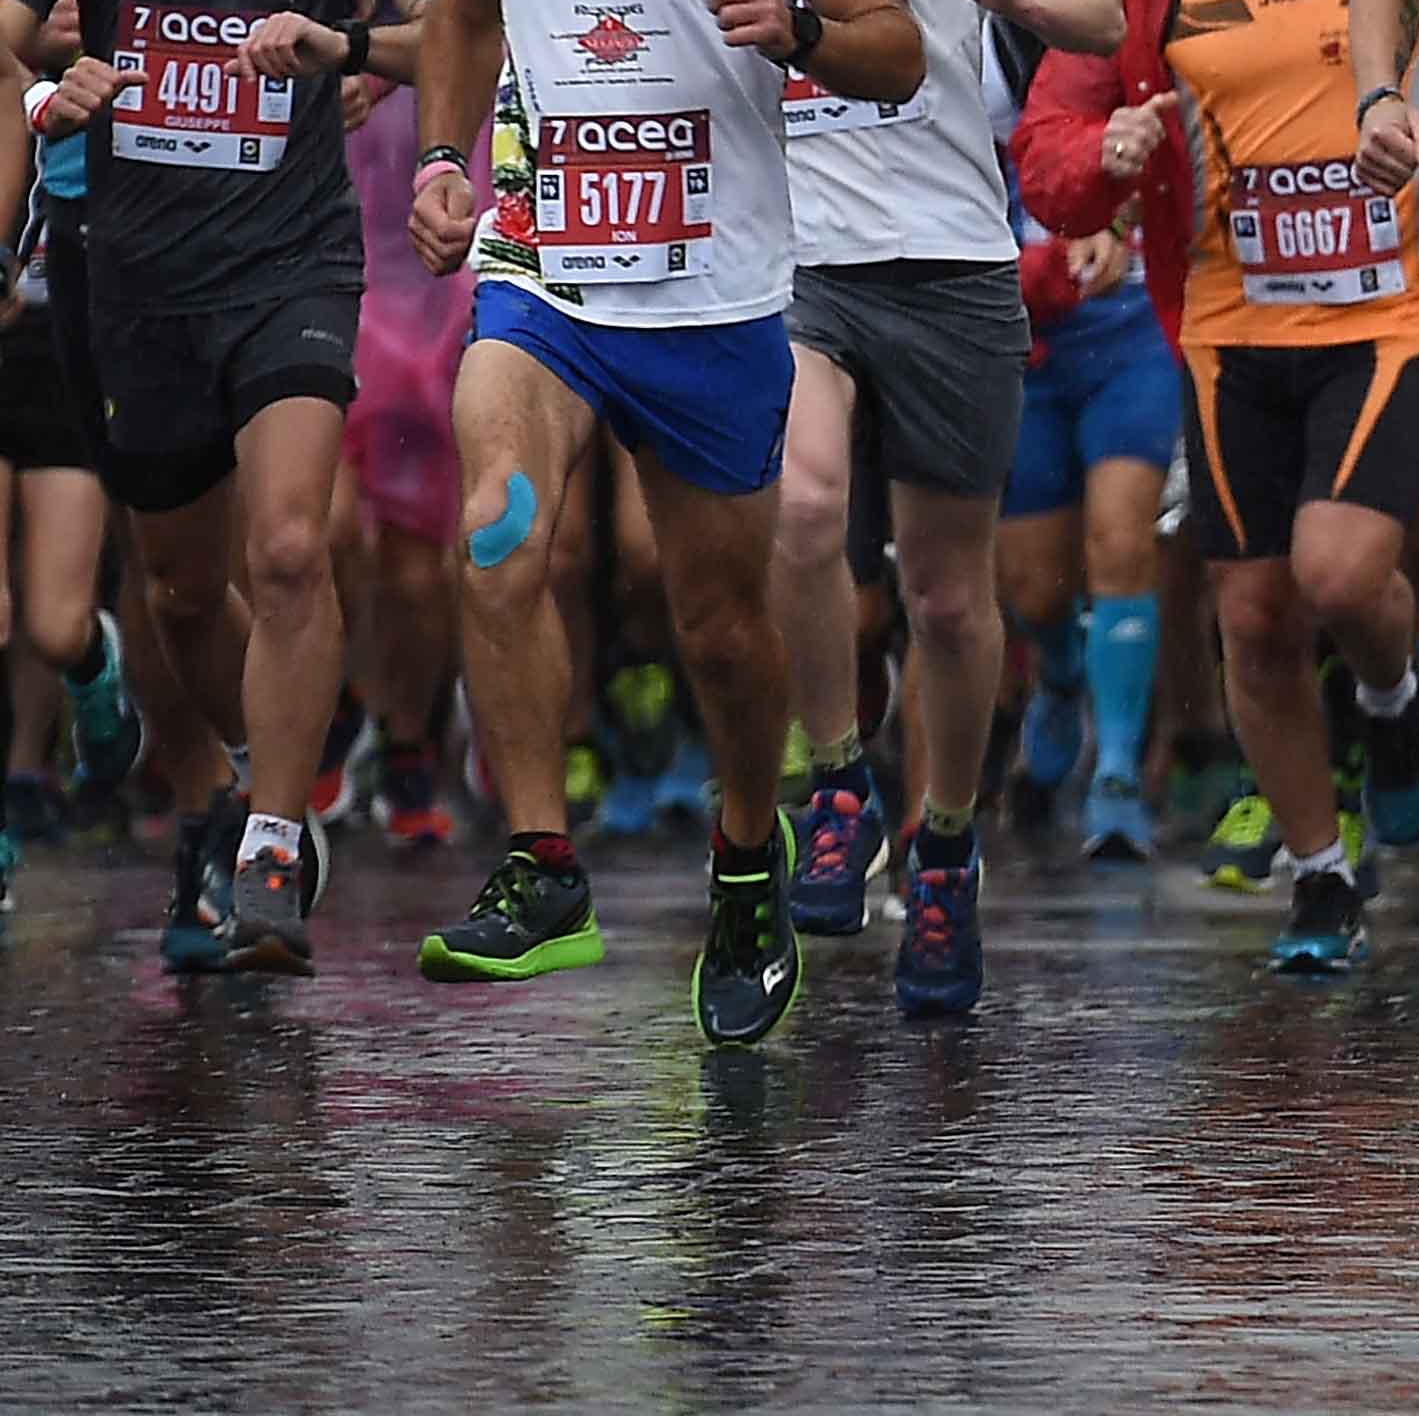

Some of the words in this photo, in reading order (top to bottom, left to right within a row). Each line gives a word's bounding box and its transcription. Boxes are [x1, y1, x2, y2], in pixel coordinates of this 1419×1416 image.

[134, 7, 151, 30] 7
[157, 60, 237, 114] 4491
[164, 115, 232, 131] GIUSEPPE
[551, 120, 567, 145] 7
[577, 118, 696, 152] acea
[135, 135, 177, 152] arena
[1242, 169, 1258, 190] 7
[1268, 162, 1360, 196] ace
[579, 171, 667, 225] 5177
[611, 230, 637, 242] ION
[1275, 206, 1351, 258] 6667
[562, 255, 606, 270] arena
